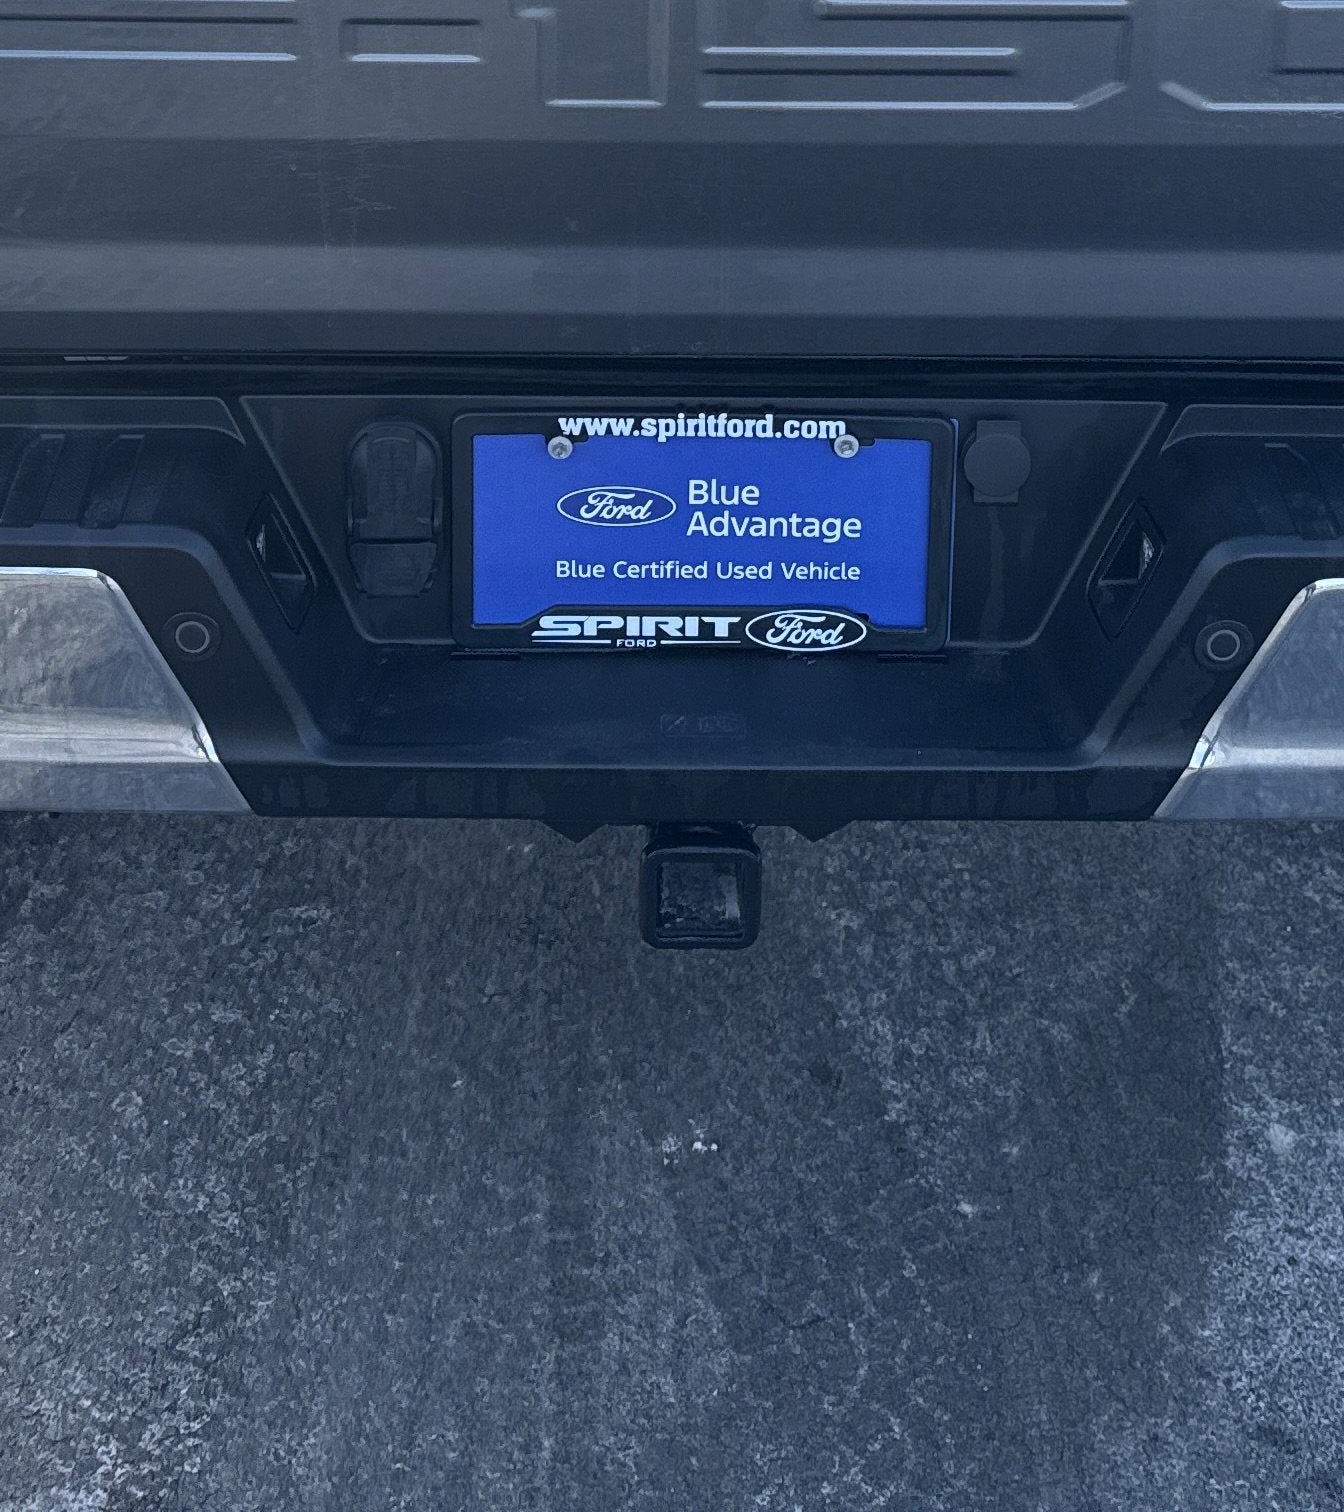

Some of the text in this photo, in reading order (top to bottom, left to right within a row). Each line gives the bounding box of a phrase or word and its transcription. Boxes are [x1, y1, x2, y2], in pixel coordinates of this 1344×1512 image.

[557, 412, 847, 442] www.spiritford.com
[579, 491, 654, 522] Ford
[687, 478, 760, 506] Blue
[686, 510, 862, 544] Advantage
[555, 559, 861, 582] Blue Certified Used Vehicle
[531, 615, 742, 638] SPIRIT
[765, 614, 844, 647] Ford
[616, 639, 657, 648] FORD
